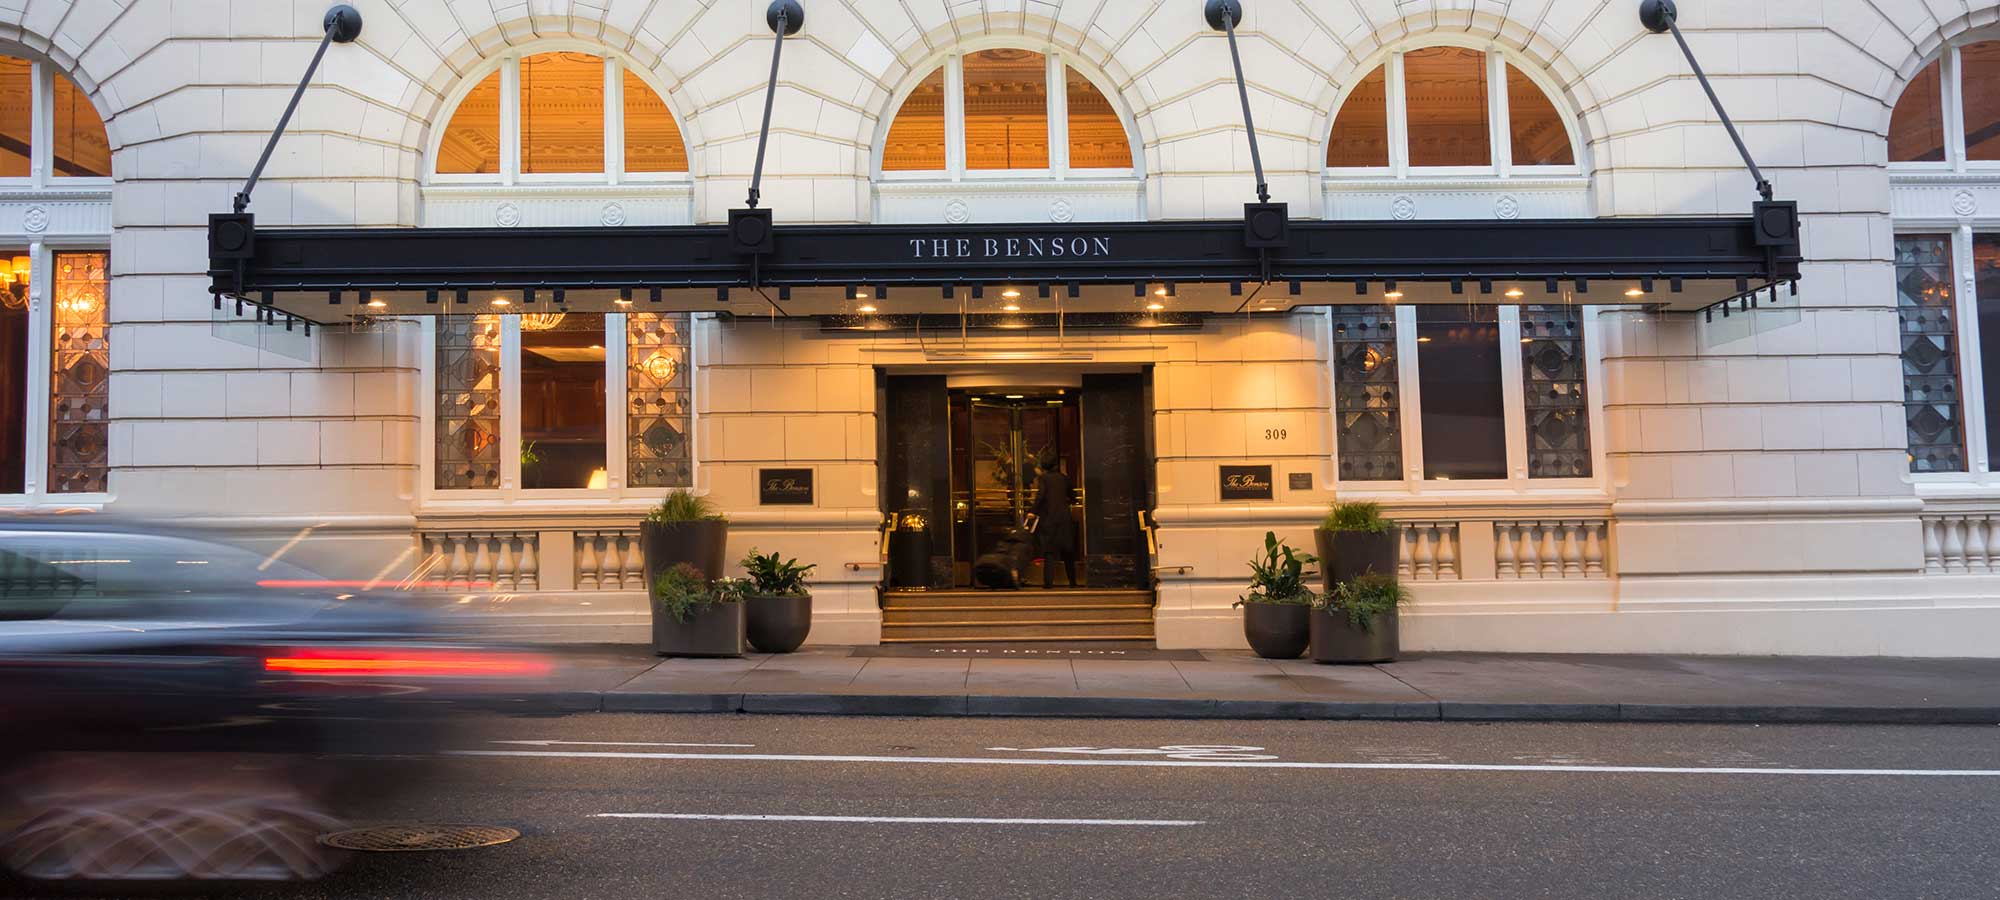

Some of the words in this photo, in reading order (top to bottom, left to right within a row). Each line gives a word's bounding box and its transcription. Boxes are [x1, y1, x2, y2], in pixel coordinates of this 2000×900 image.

[910, 239, 971, 257] THE
[984, 237, 1110, 257] BENSON
[1265, 429, 1287, 440] 309
